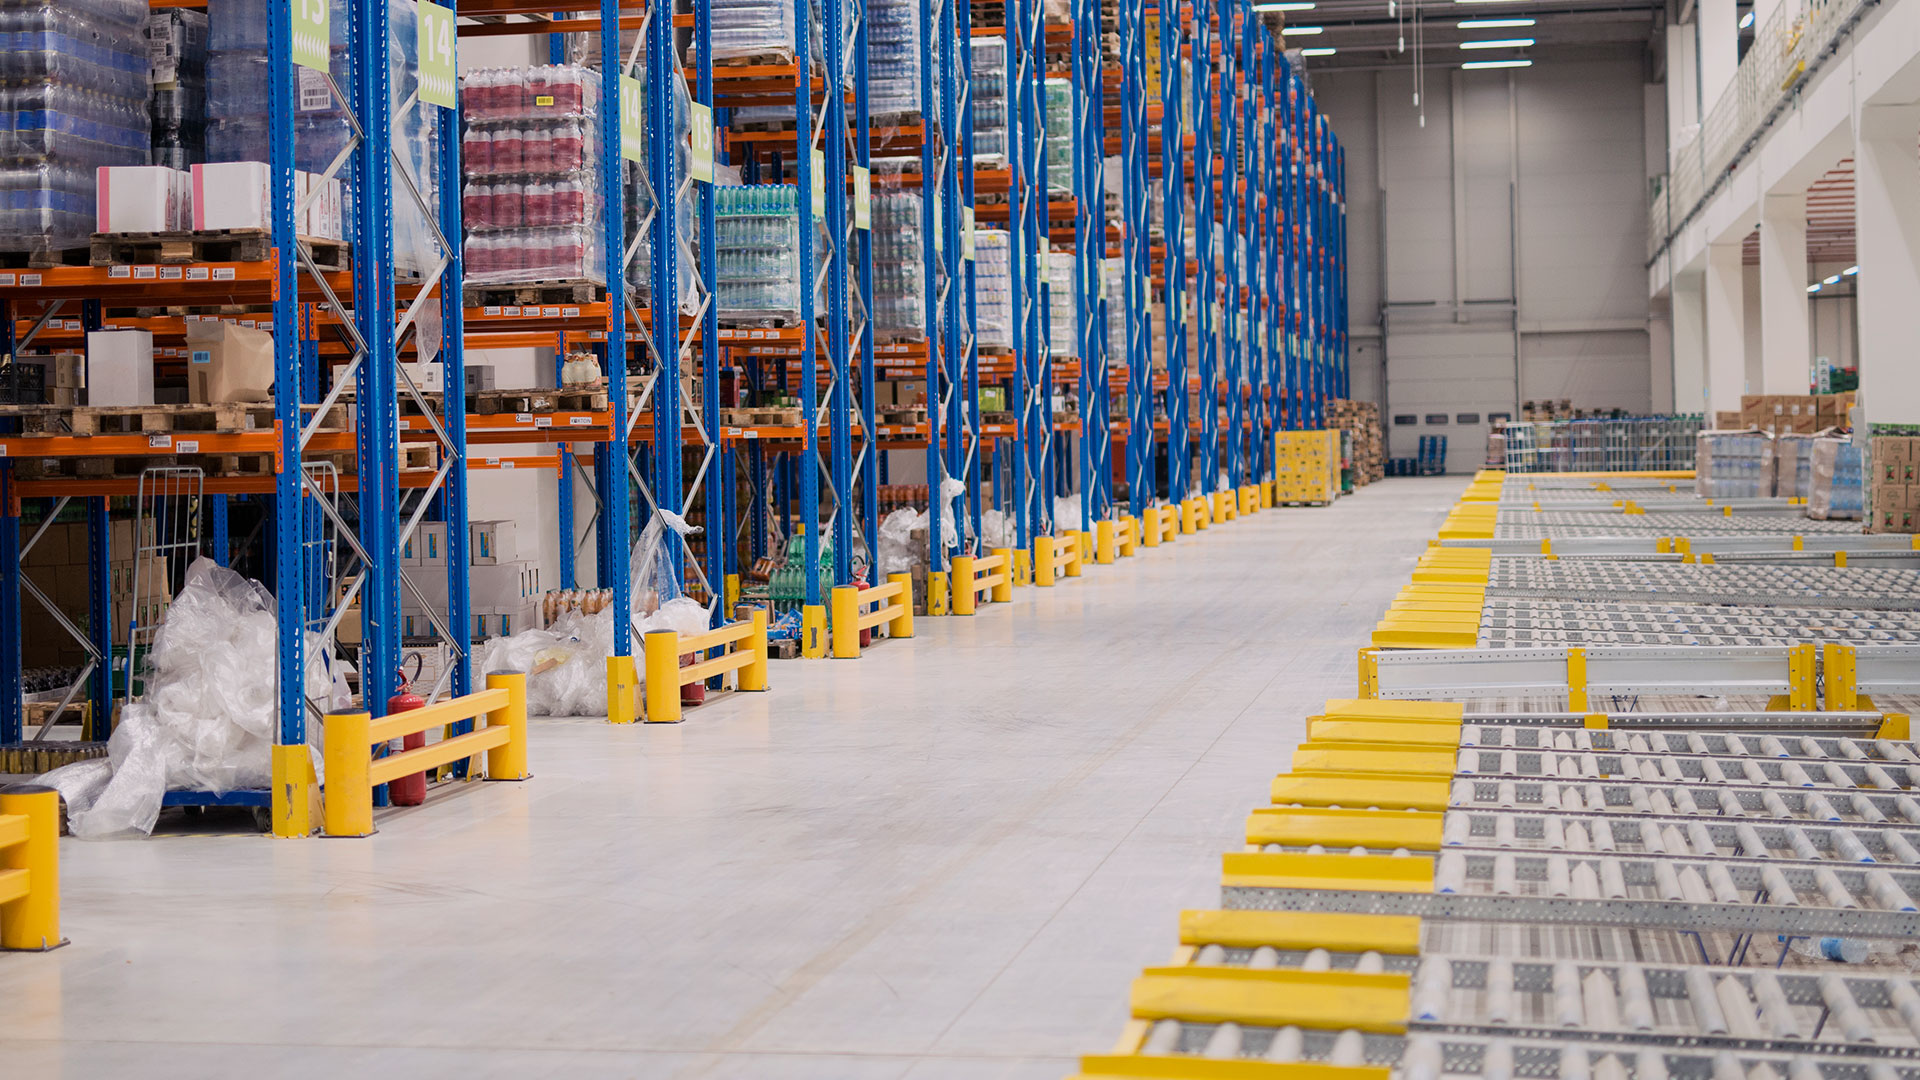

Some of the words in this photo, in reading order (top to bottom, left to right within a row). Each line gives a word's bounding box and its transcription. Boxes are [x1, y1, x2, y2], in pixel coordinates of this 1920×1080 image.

[424, 14, 451, 66] 14
[623, 86, 639, 128] 14
[695, 112, 709, 151] 15
[812, 157, 823, 190] 15
[857, 174, 868, 204] 16
[108, 266, 112, 277] 8
[134, 268, 138, 277] 7
[160, 268, 164, 278] 6
[186, 269, 191, 279] 5
[150, 436, 154, 446] 2
